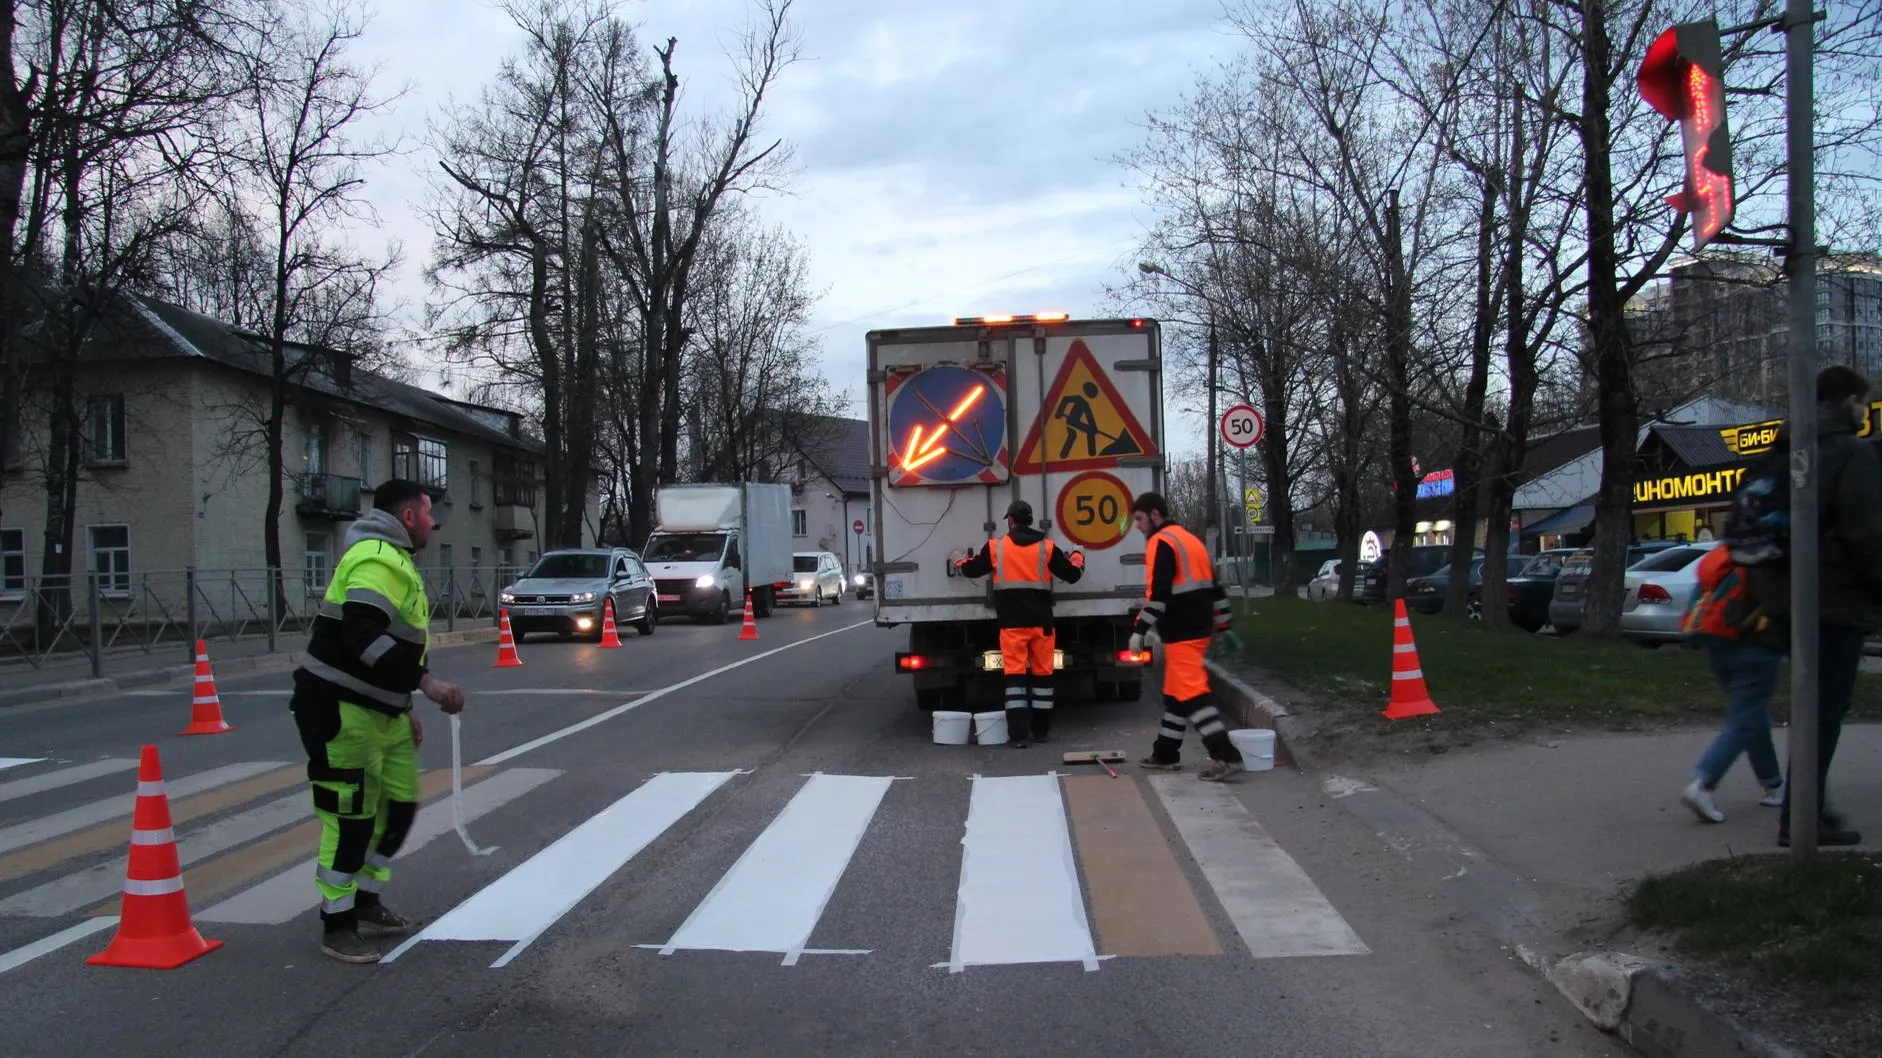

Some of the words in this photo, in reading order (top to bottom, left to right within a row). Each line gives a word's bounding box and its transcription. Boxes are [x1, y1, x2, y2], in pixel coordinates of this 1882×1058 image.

[1231, 418, 1253, 435] 50
[1633, 467, 1747, 502] ИНОМОНТ
[1076, 495, 1118, 525] 50
